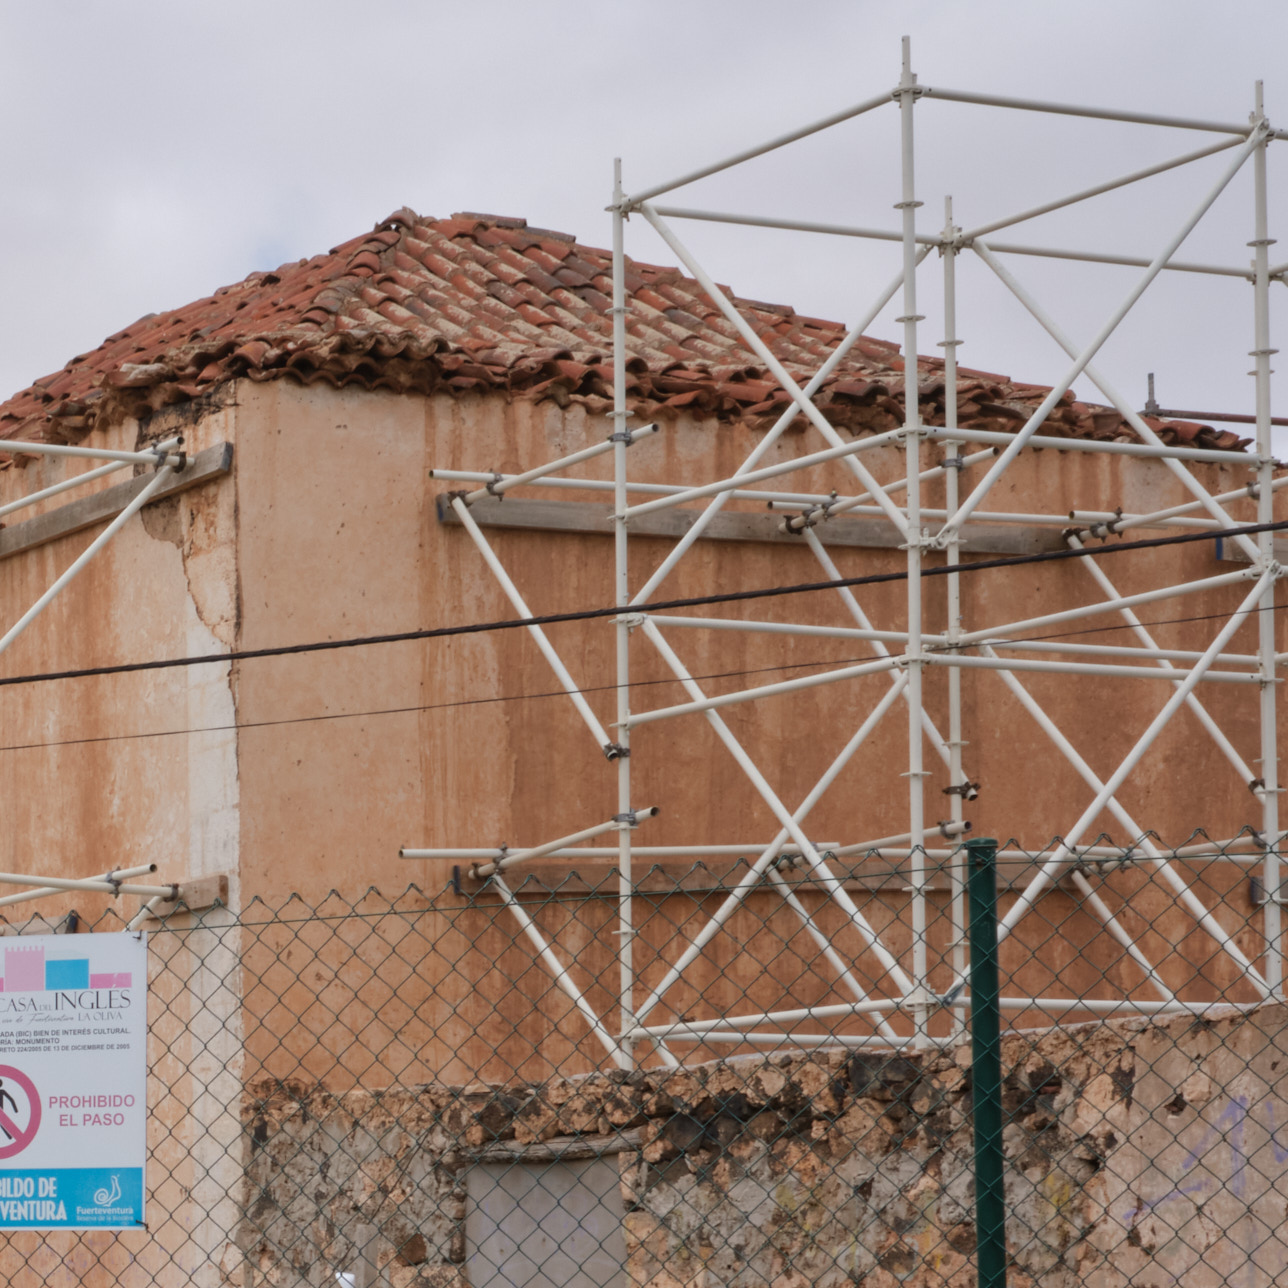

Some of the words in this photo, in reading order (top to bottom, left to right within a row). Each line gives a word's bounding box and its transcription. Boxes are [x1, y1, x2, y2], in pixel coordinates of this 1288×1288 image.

[55, 984, 131, 1010] INGLÉS
[78, 1012, 90, 1021] LA
[93, 1011, 123, 1021] OLIVA
[15, 1030, 32, 1038] (BIC)
[33, 1029, 49, 1037] BIEN
[62, 1027, 91, 1036] INTERÉS
[15, 1037, 60, 1045] MONUMENTO
[49, 1094, 135, 1109] PROHIBIDO
[59, 1114, 78, 1127] EL
[83, 1113, 125, 1126] PASO
[38, 1177, 57, 1198] DE
[76, 1206, 134, 1215] Fuerteventura
